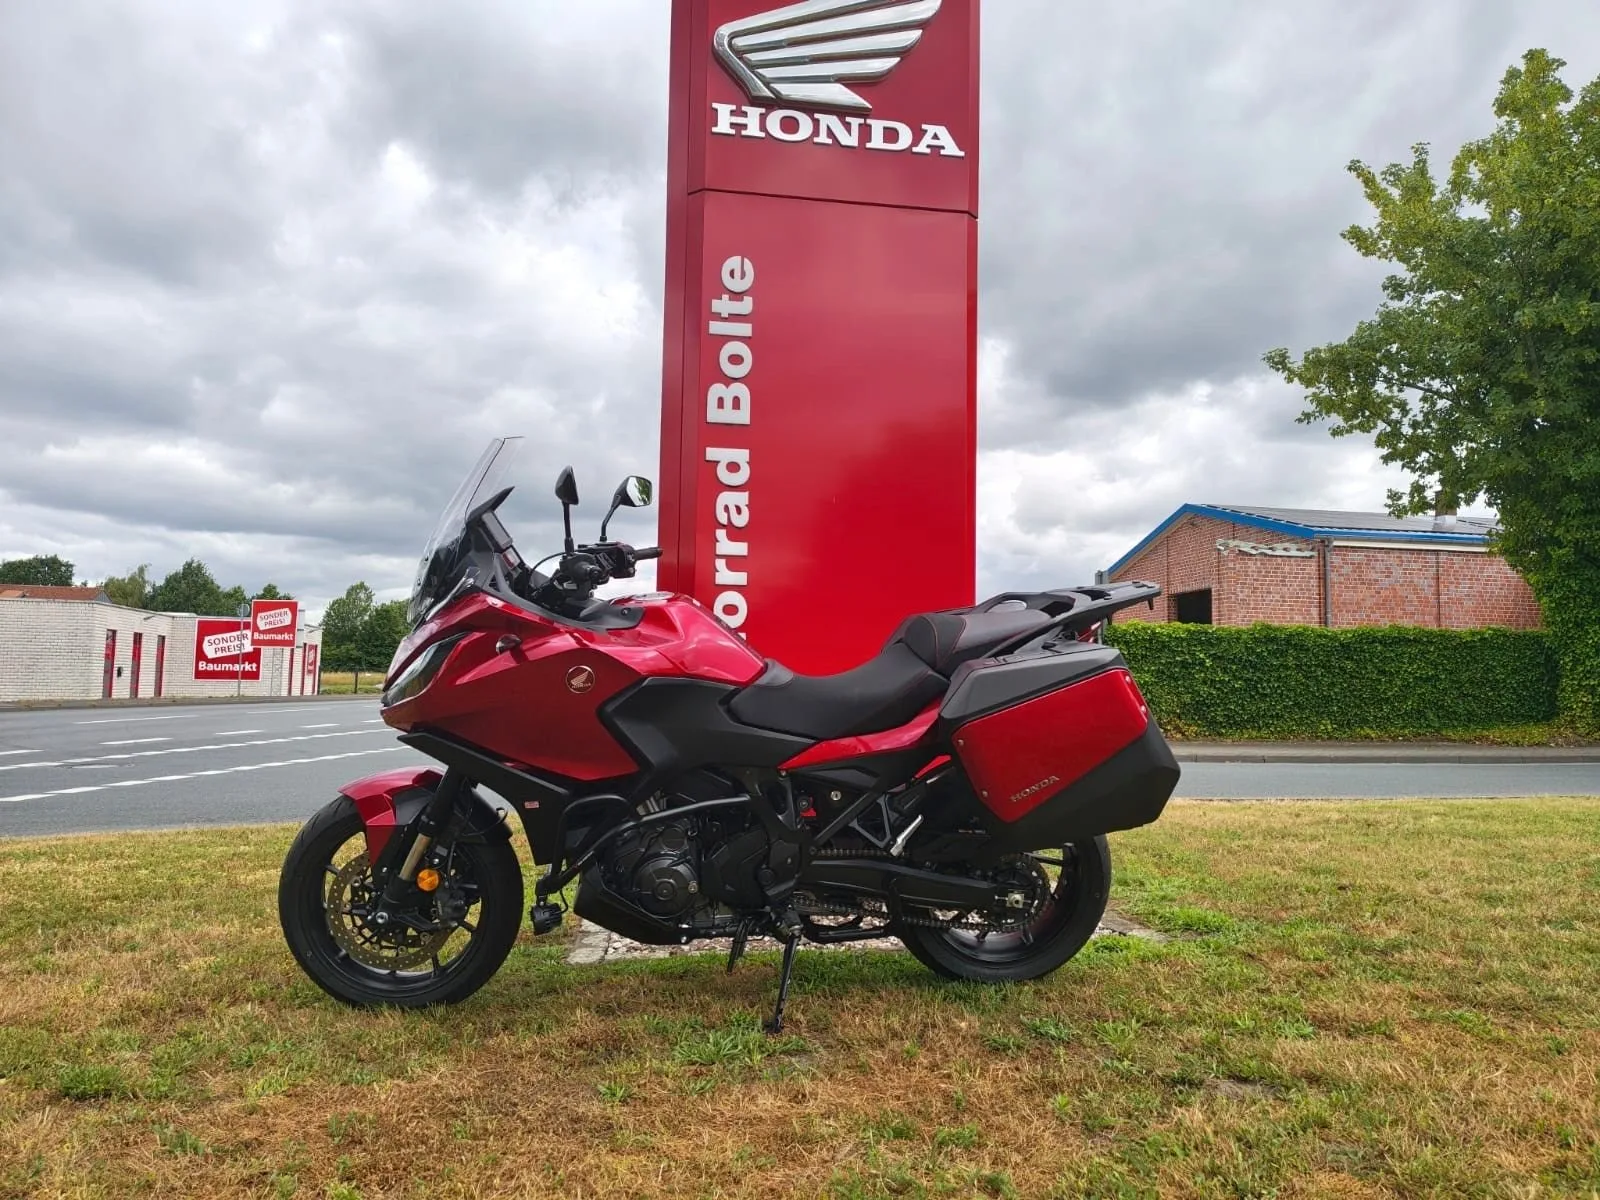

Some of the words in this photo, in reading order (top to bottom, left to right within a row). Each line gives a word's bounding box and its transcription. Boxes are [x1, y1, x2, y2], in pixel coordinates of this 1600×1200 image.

[711, 102, 965, 157] HONDA
[706, 255, 755, 425] Bolte
[705, 447, 751, 640] orrad
[259, 610, 288, 621] SONDER
[207, 633, 249, 646] SONDER
[253, 632, 294, 640] Baumarkt
[214, 643, 245, 654] PREIS!
[198, 661, 257, 671] Baumarkt
[1010, 775, 1060, 802] HONDA
